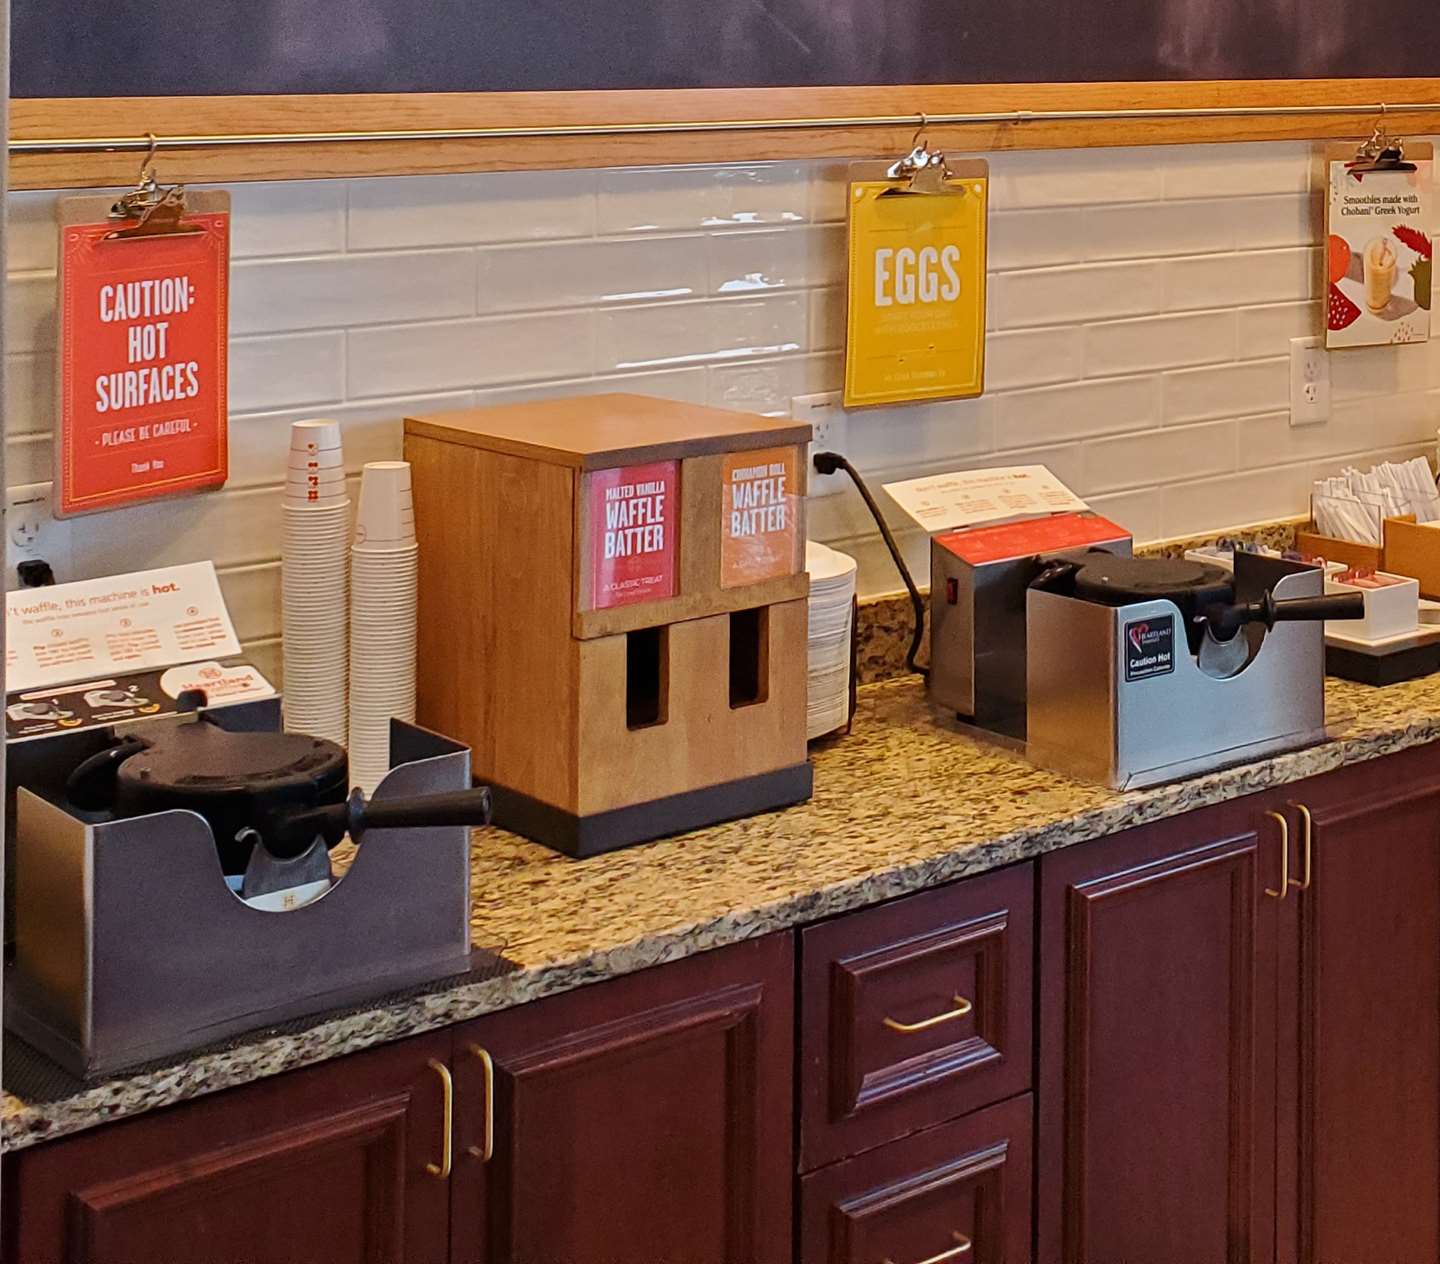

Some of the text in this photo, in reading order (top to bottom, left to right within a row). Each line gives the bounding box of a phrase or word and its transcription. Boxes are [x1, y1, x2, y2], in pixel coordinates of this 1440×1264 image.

[1343, 193, 1418, 205] Smoothies made with
[1374, 206, 1396, 215] Greek
[1397, 206, 1420, 216] Yogurt
[875, 245, 960, 307] EGGS
[99, 276, 195, 323] CAUTION:
[128, 322, 168, 363] HOT
[95, 361, 199, 413] SURFACES
[606, 485, 634, 501] MALTED
[732, 477, 786, 510] WAFFLE
[605, 495, 665, 529] WAFFLE
[730, 505, 785, 537] BATTER
[604, 524, 664, 560] BATTER
[64, 596, 86, 608] this
[151, 582, 181, 595] hot.
[1130, 652, 1170, 668] Caution Hot
